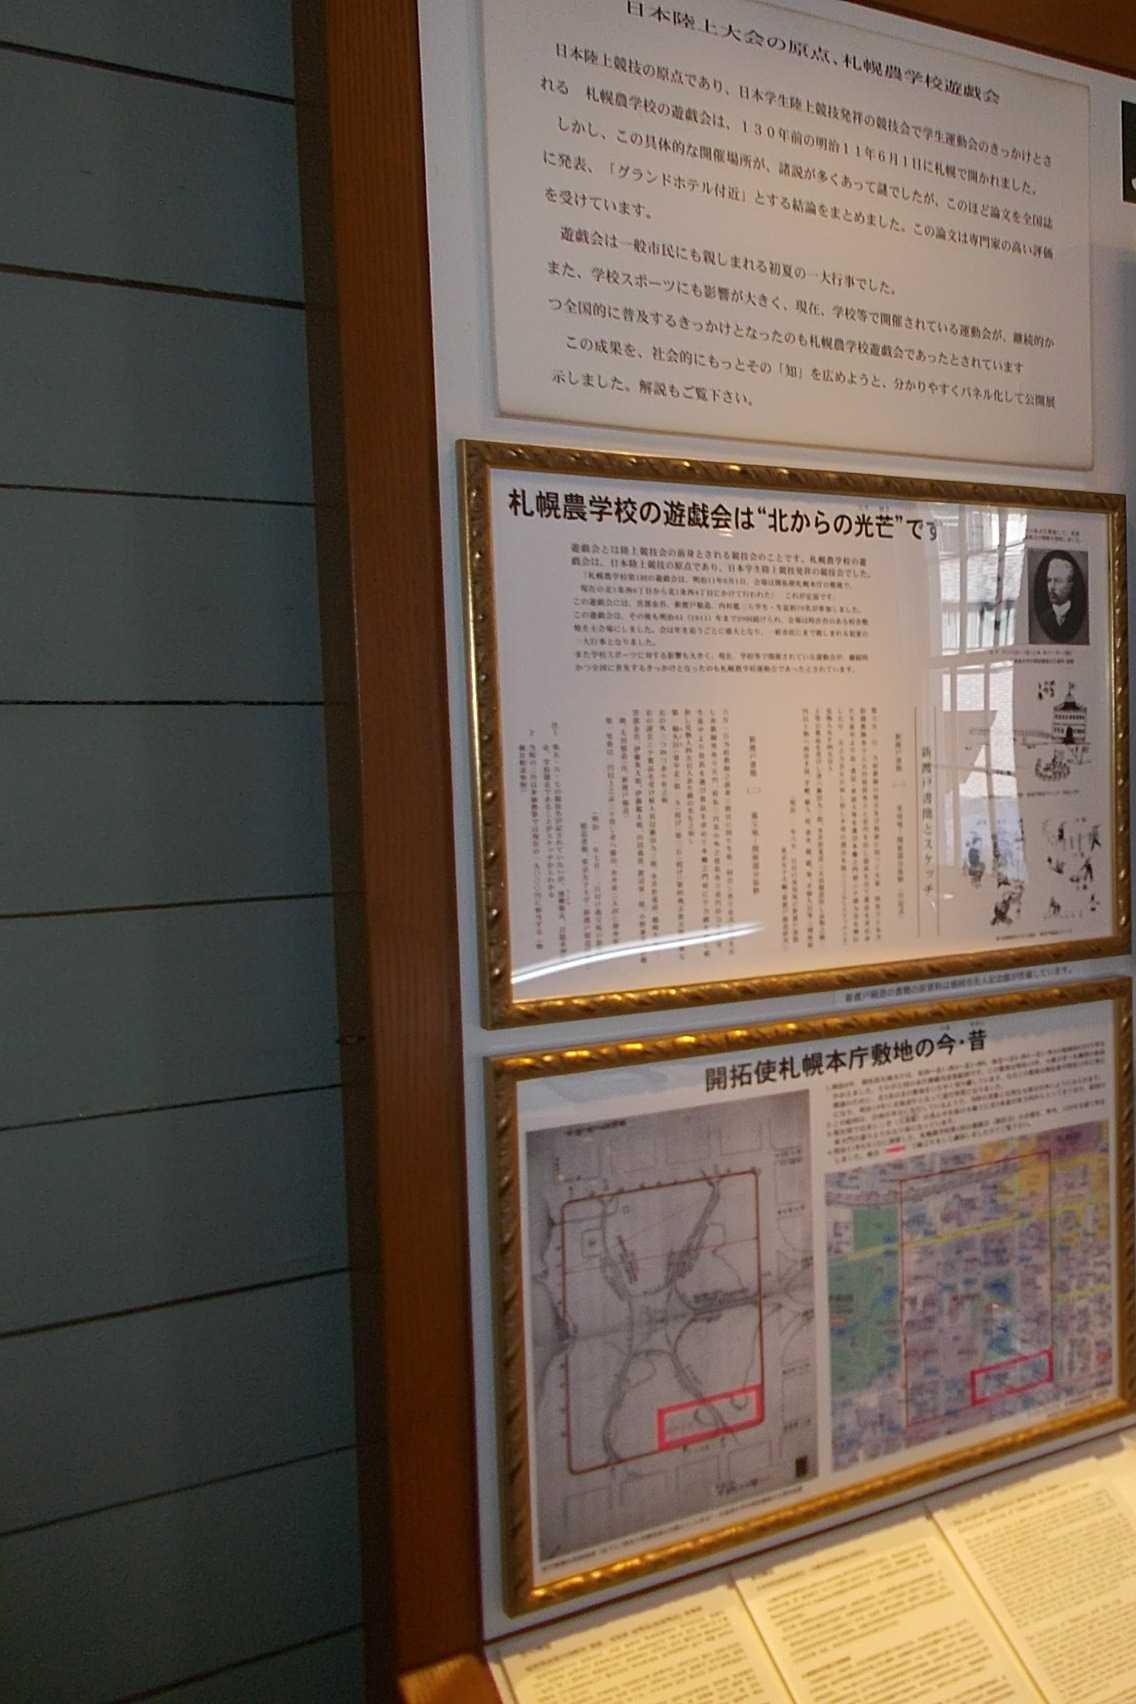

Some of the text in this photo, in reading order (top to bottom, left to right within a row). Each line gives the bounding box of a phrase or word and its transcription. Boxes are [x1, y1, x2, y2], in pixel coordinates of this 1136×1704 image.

[627, 0, 1000, 106] 日本陸上大会の原点、札幌農学校遊戯会
[540, 76, 569, 96] れる
[544, 187, 653, 219] を受けています。
[551, 370, 753, 406] 示しました。解説もご覧下さい。
